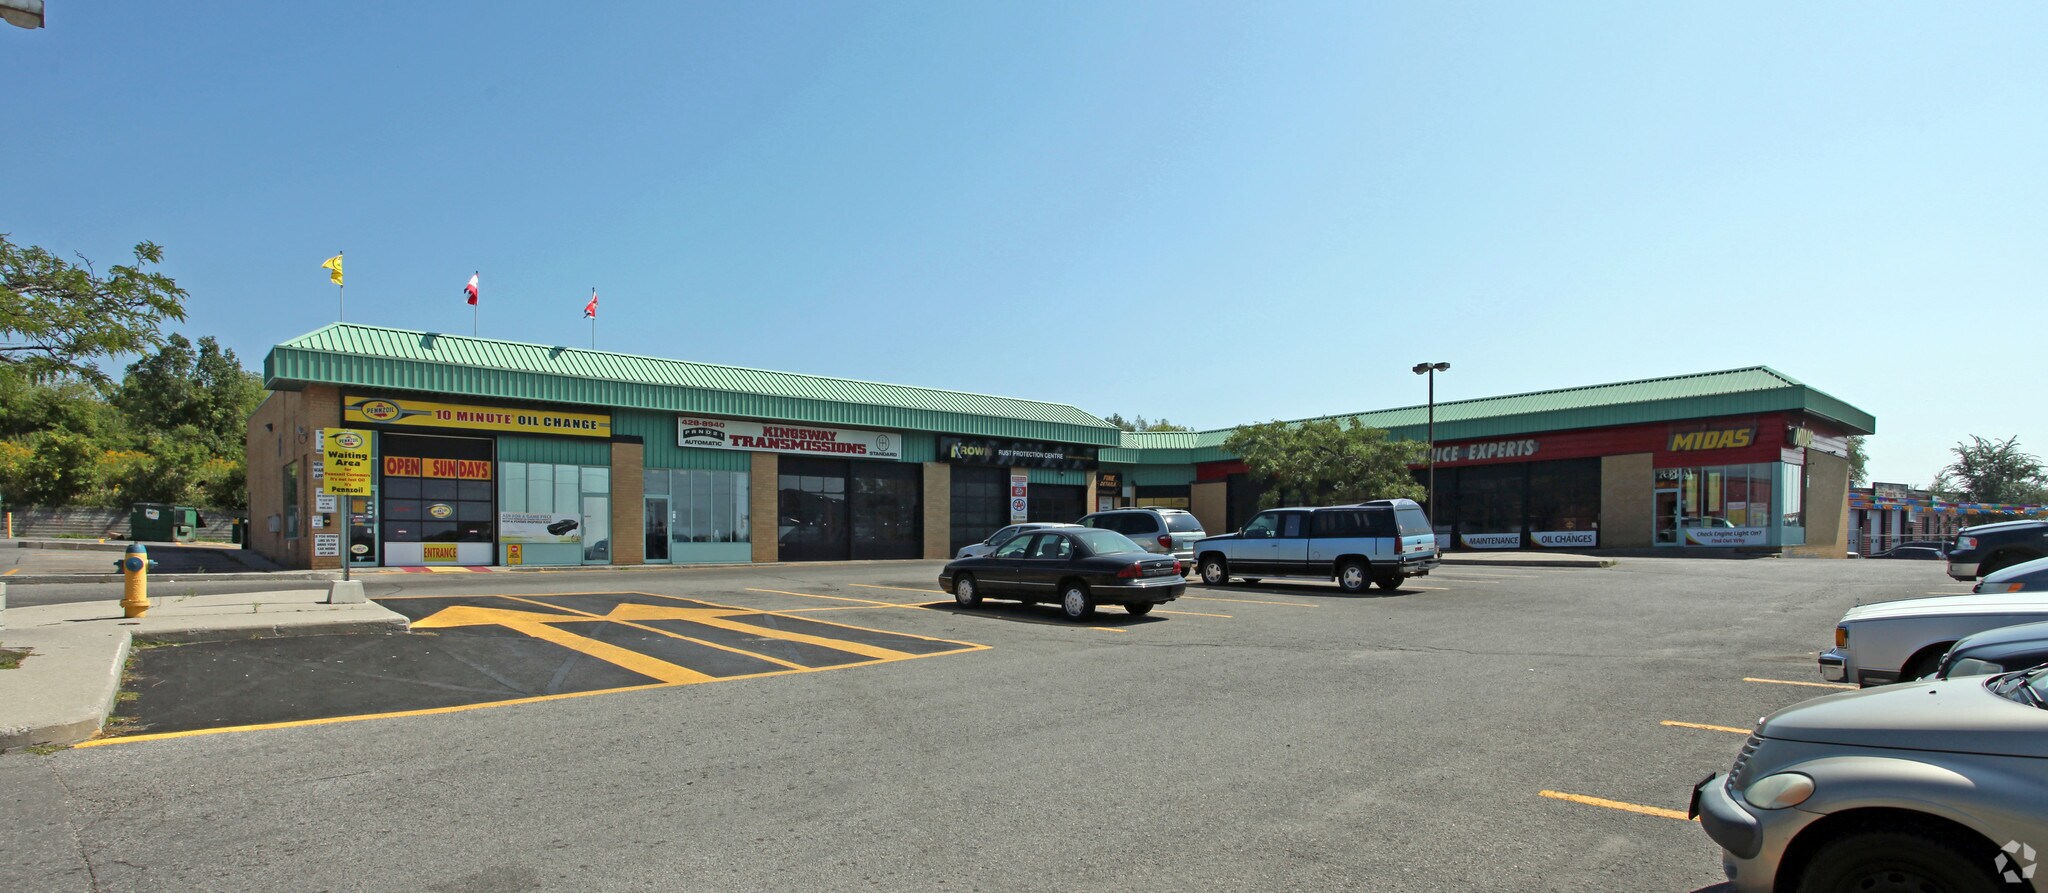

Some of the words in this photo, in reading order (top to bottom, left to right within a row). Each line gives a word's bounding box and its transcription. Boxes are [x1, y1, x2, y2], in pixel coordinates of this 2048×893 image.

[435, 409, 452, 420] 10
[456, 411, 511, 424] MINUTE
[518, 415, 539, 426] OIL
[543, 417, 597, 430] CHANGE
[682, 419, 725, 429] 428-8940
[762, 426, 837, 441] KINGSWAY
[1671, 428, 1751, 452] MIDAS
[684, 439, 722, 447] AUTOMATIC
[729, 434, 867, 455] TRANSMISSIONS
[950, 442, 993, 459] KROWN
[1013, 450, 1043, 458] PROTECTION
[1468, 440, 1535, 460] EXPERTS
[328, 451, 368, 460] Waiting
[386, 457, 420, 475] OPEN
[1469, 536, 1519, 545] MAINTENANCE
[1541, 536, 1553, 544] OIL
[1555, 535, 1592, 544] CHANGES
[424, 548, 456, 558] ENTRANCE
